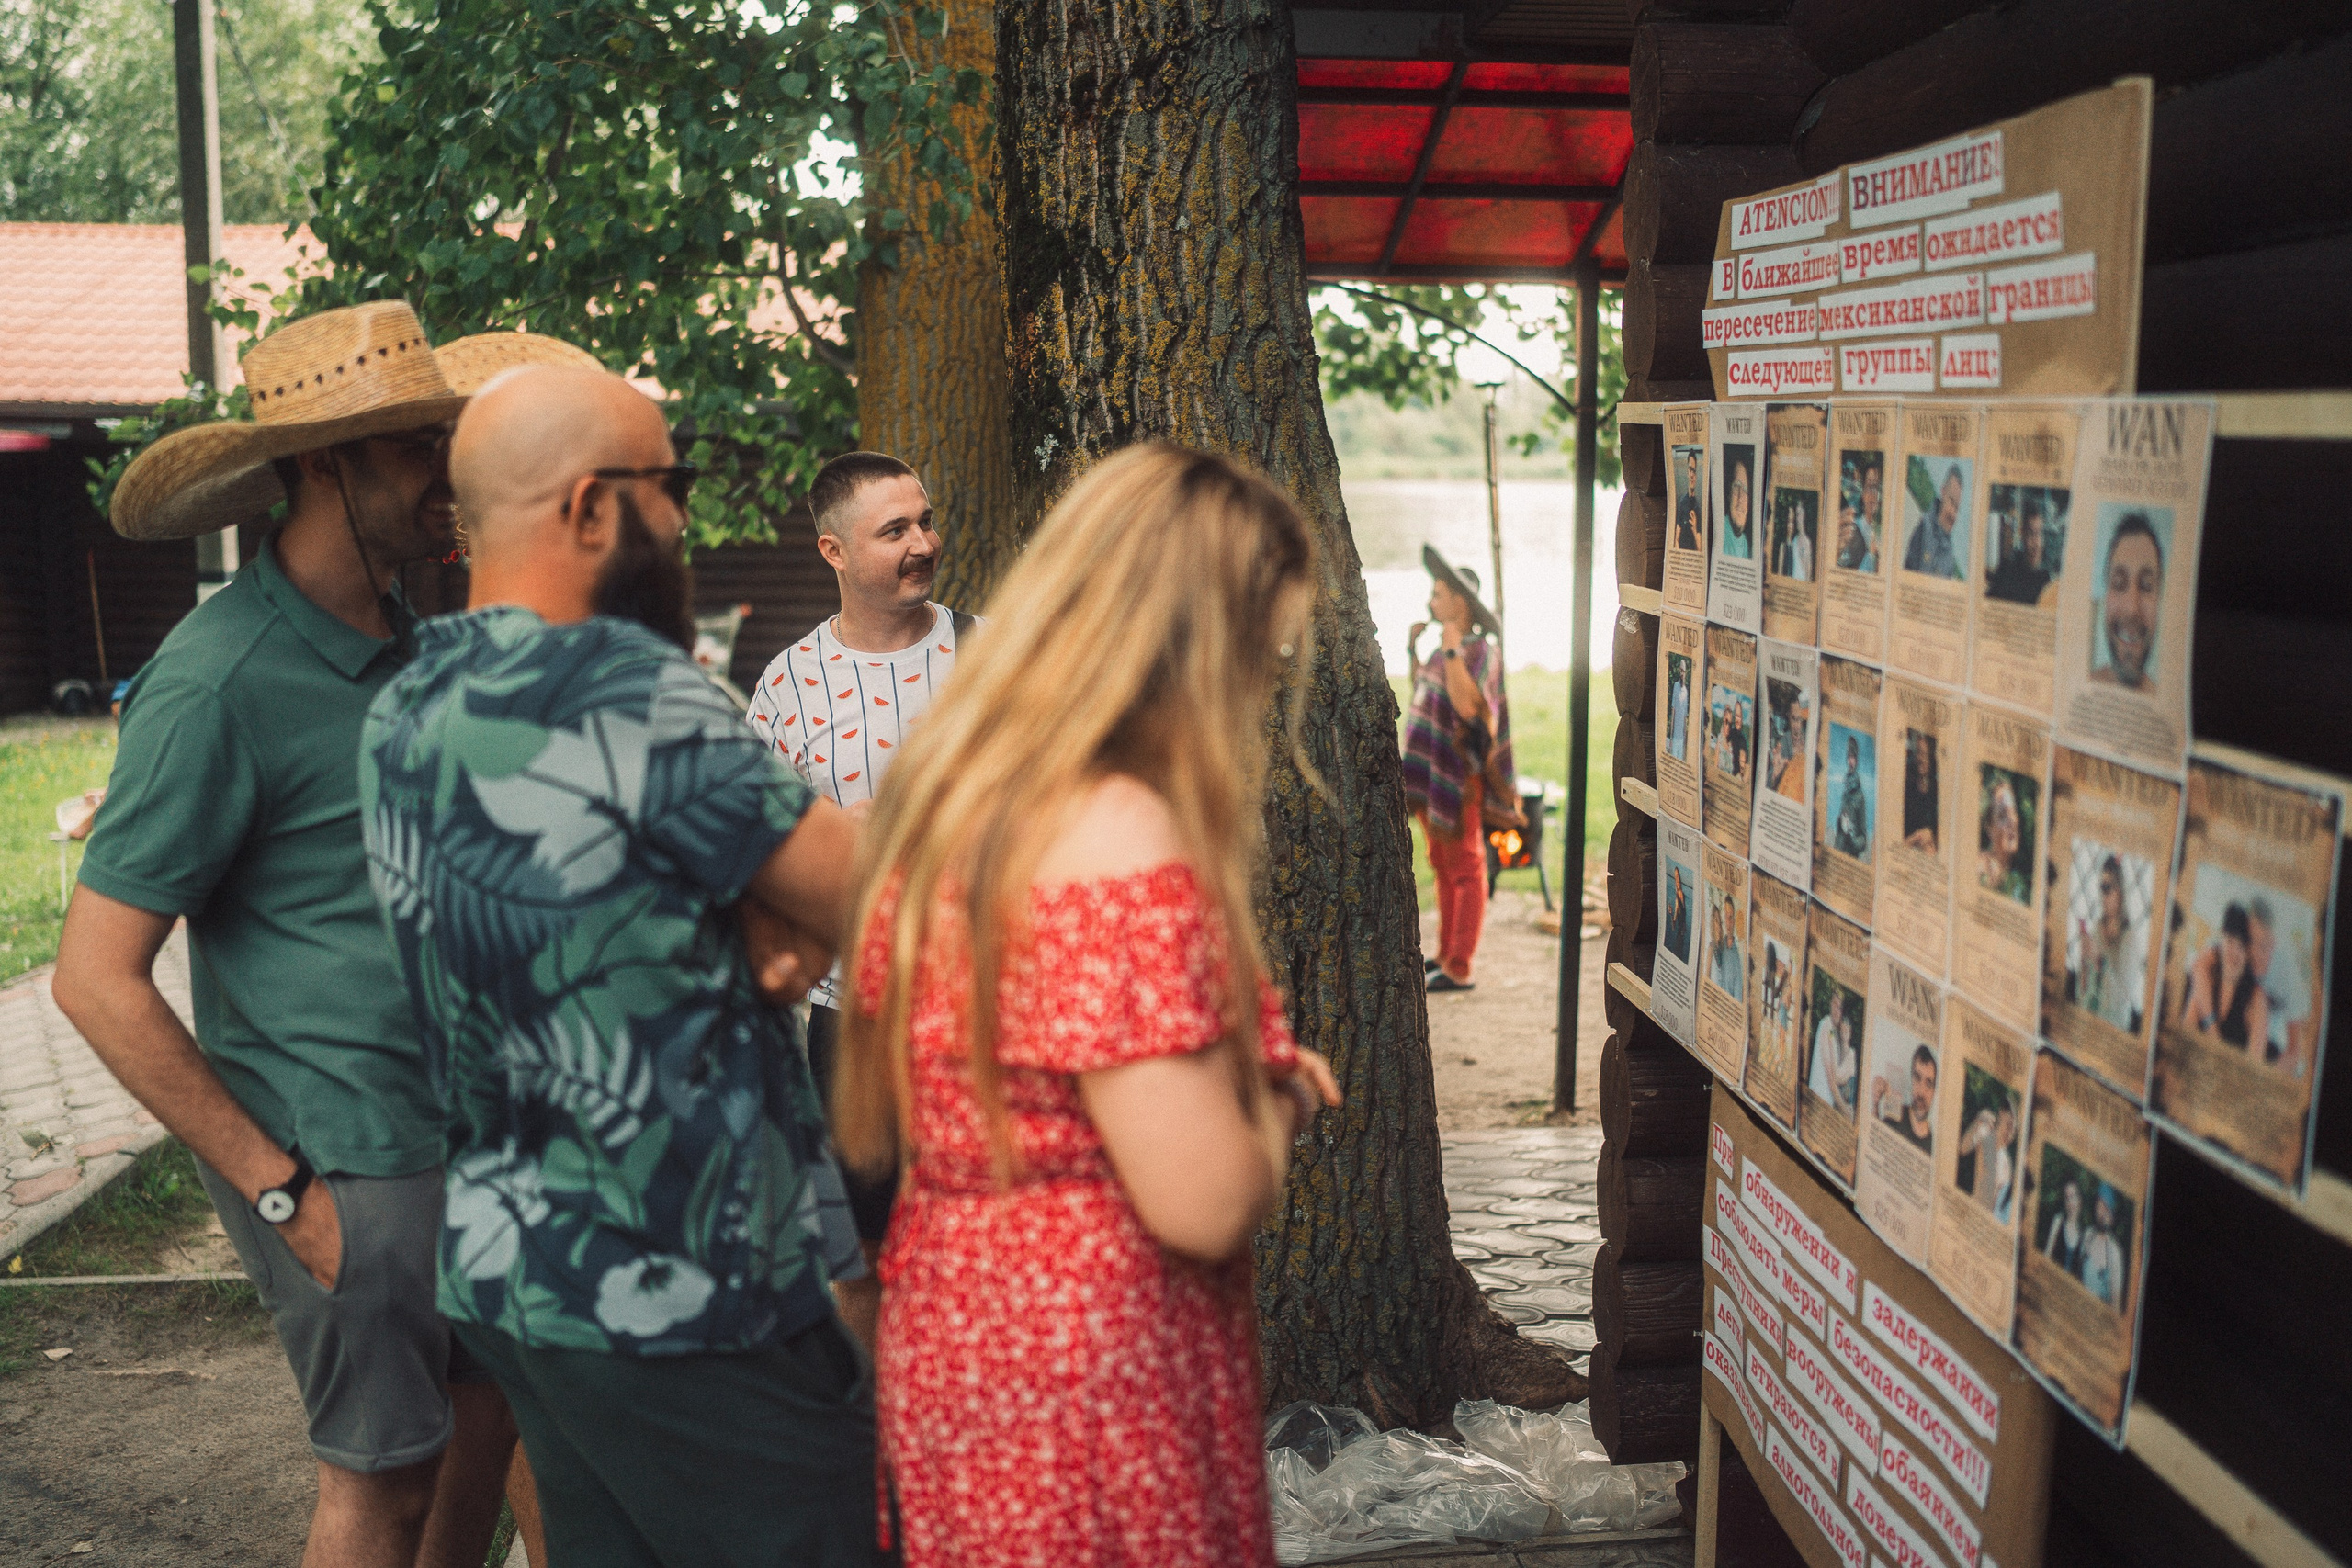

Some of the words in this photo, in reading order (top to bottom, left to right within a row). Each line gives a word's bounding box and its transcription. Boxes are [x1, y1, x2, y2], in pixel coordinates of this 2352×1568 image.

[1852, 139, 2000, 211] ВНИМАНИЕ!
[1722, 261, 1734, 292] В
[1741, 246, 1838, 291] ближайшее
[1843, 231, 1919, 277] время
[1926, 209, 2061, 262] ожидается
[1703, 304, 1815, 346] пересечение
[1818, 274, 1981, 332] мексиканской
[1728, 347, 1832, 393] следующей
[1845, 345, 1932, 385] группы
[1945, 348, 1997, 380] лиц:
[1669, 413, 1703, 433] WANTED
[1726, 418, 1751, 434] WANTED
[1774, 423, 1818, 449] WANTED
[1838, 412, 1886, 435] WANTED
[1912, 413, 1971, 442] WANTED
[1998, 434, 2064, 462] WANTED
[1666, 621, 1698, 649] WANTED
[1712, 632, 1752, 664] WANTED
[1770, 654, 1800, 677] WANTED
[1826, 660, 1874, 699] WANTED
[1668, 829, 1689, 852] WANTED
[1706, 849, 1742, 886] WANTED
[1757, 874, 1802, 921] WANTED
[1815, 907, 1865, 961] WANTED
[1713, 1124, 1734, 1168] При
[1746, 1171, 1841, 1280] обнаружении
[1846, 1268, 1857, 1296] и
[1872, 1296, 1997, 1429] задержании
[1718, 1193, 1779, 1278] соблюдать
[1782, 1269, 1824, 1325] меры
[1834, 1319, 1985, 1493] безопасности!!!
[1711, 1232, 1782, 1349] Преступники
[1787, 1338, 1879, 1457] вооружены
[1883, 1448, 1977, 1568] обаянием
[1706, 1341, 1762, 1441] оказывают
[1772, 1444, 1862, 1568] алкогольное
[1751, 1354, 1826, 1464] втираются
[1853, 1488, 1932, 1568] довери
